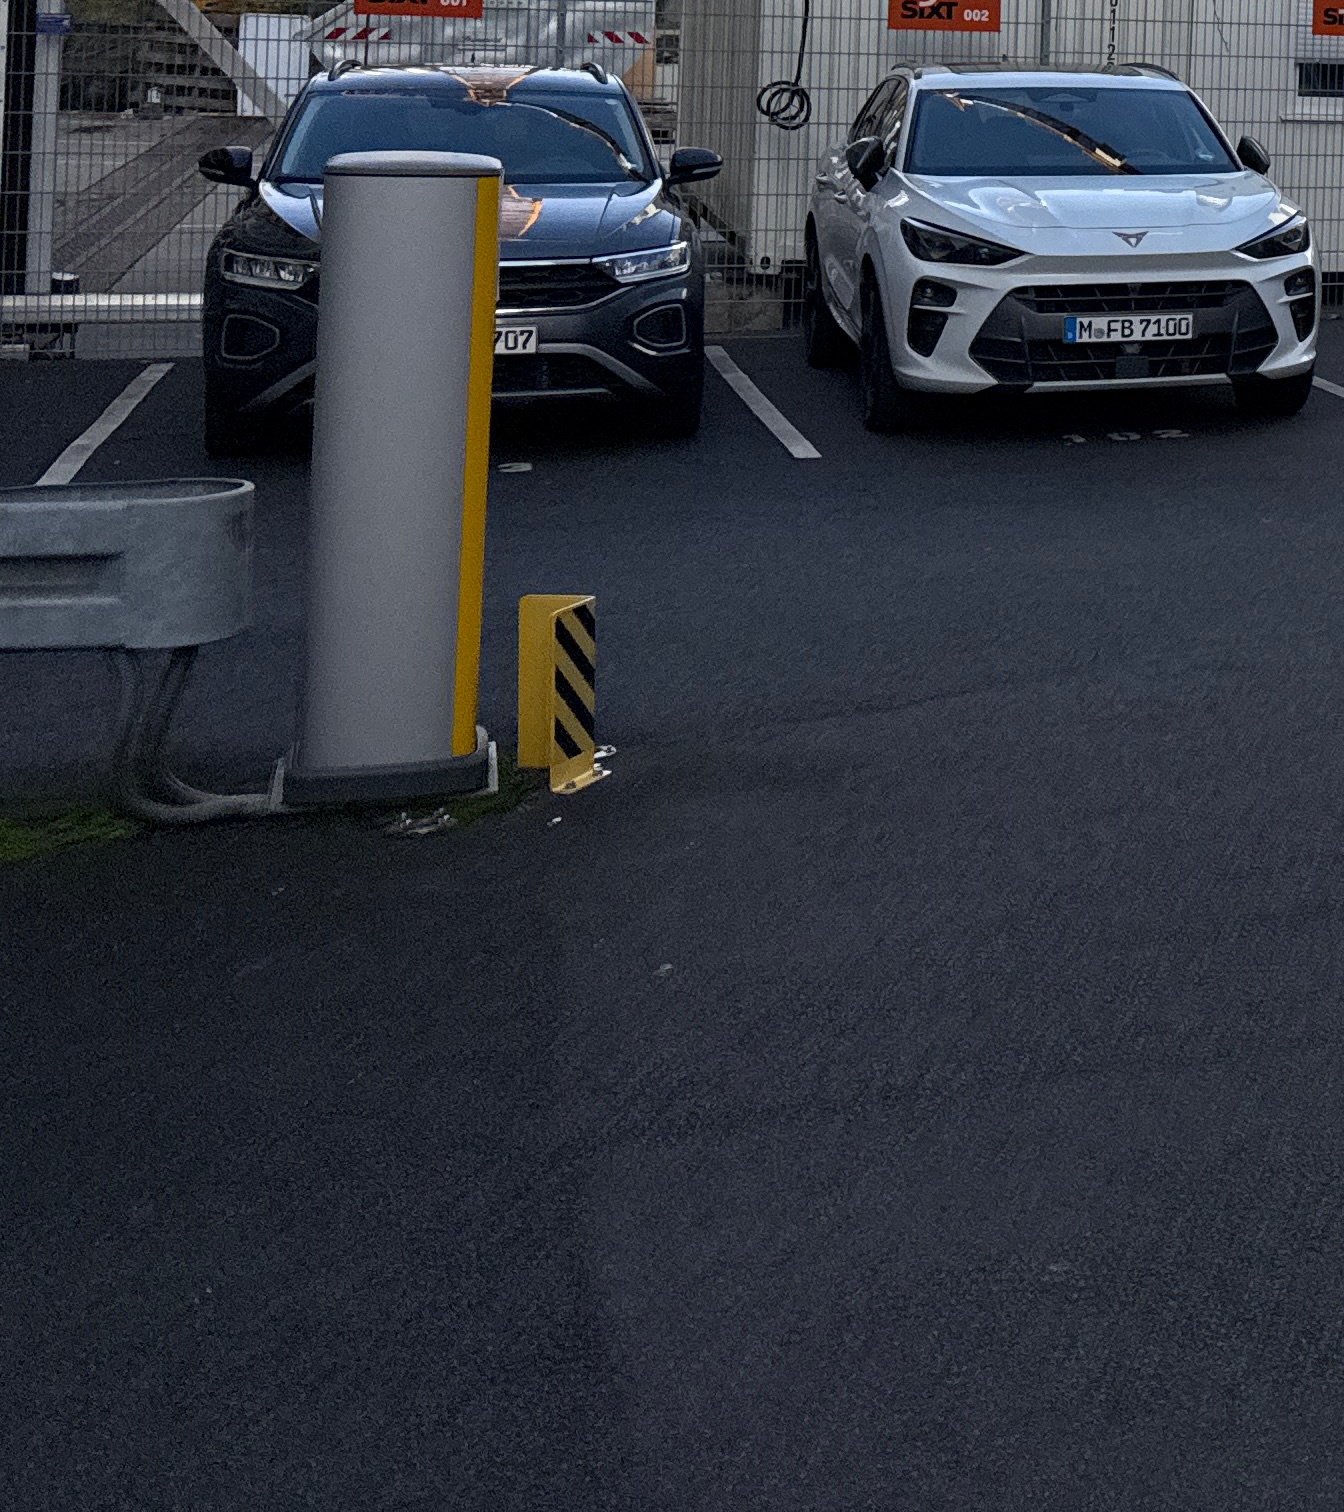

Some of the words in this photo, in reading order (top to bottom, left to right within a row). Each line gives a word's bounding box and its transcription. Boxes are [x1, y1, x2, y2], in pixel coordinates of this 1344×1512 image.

[963, 9, 990, 22] 002
[1078, 320, 1093, 340] M
[1106, 319, 1134, 339] FB
[1139, 317, 1190, 338] 7100
